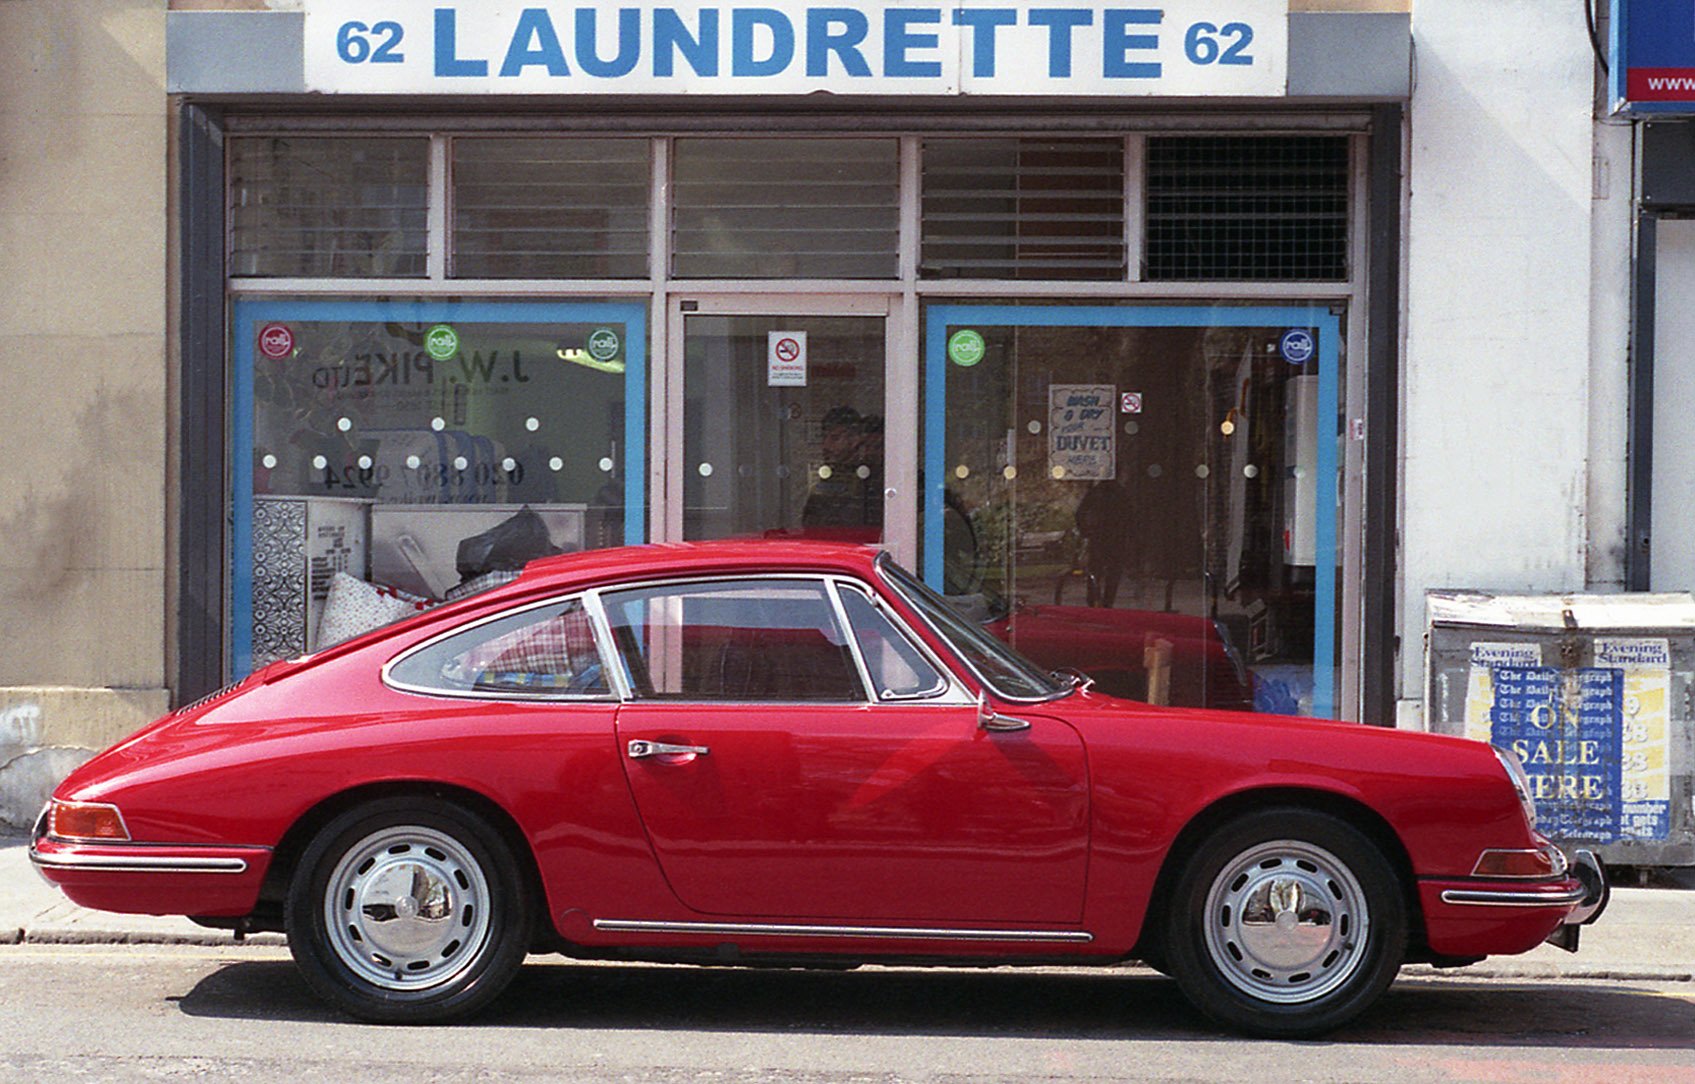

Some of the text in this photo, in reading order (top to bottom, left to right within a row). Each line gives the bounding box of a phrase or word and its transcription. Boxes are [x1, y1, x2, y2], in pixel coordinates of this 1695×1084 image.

[336, 8, 1253, 78] 62 LAUNDRETTE 62
[1078, 408, 1105, 421] DRY
[1056, 435, 1112, 451] DUVET
[1473, 646, 1535, 658] Evening
[1602, 643, 1664, 655] Evening
[1598, 652, 1667, 664] Standard
[1500, 669, 1522, 680] The
[1500, 683, 1522, 694] The
[1530, 704, 1580, 730] ON
[1512, 739, 1599, 765] SALE
